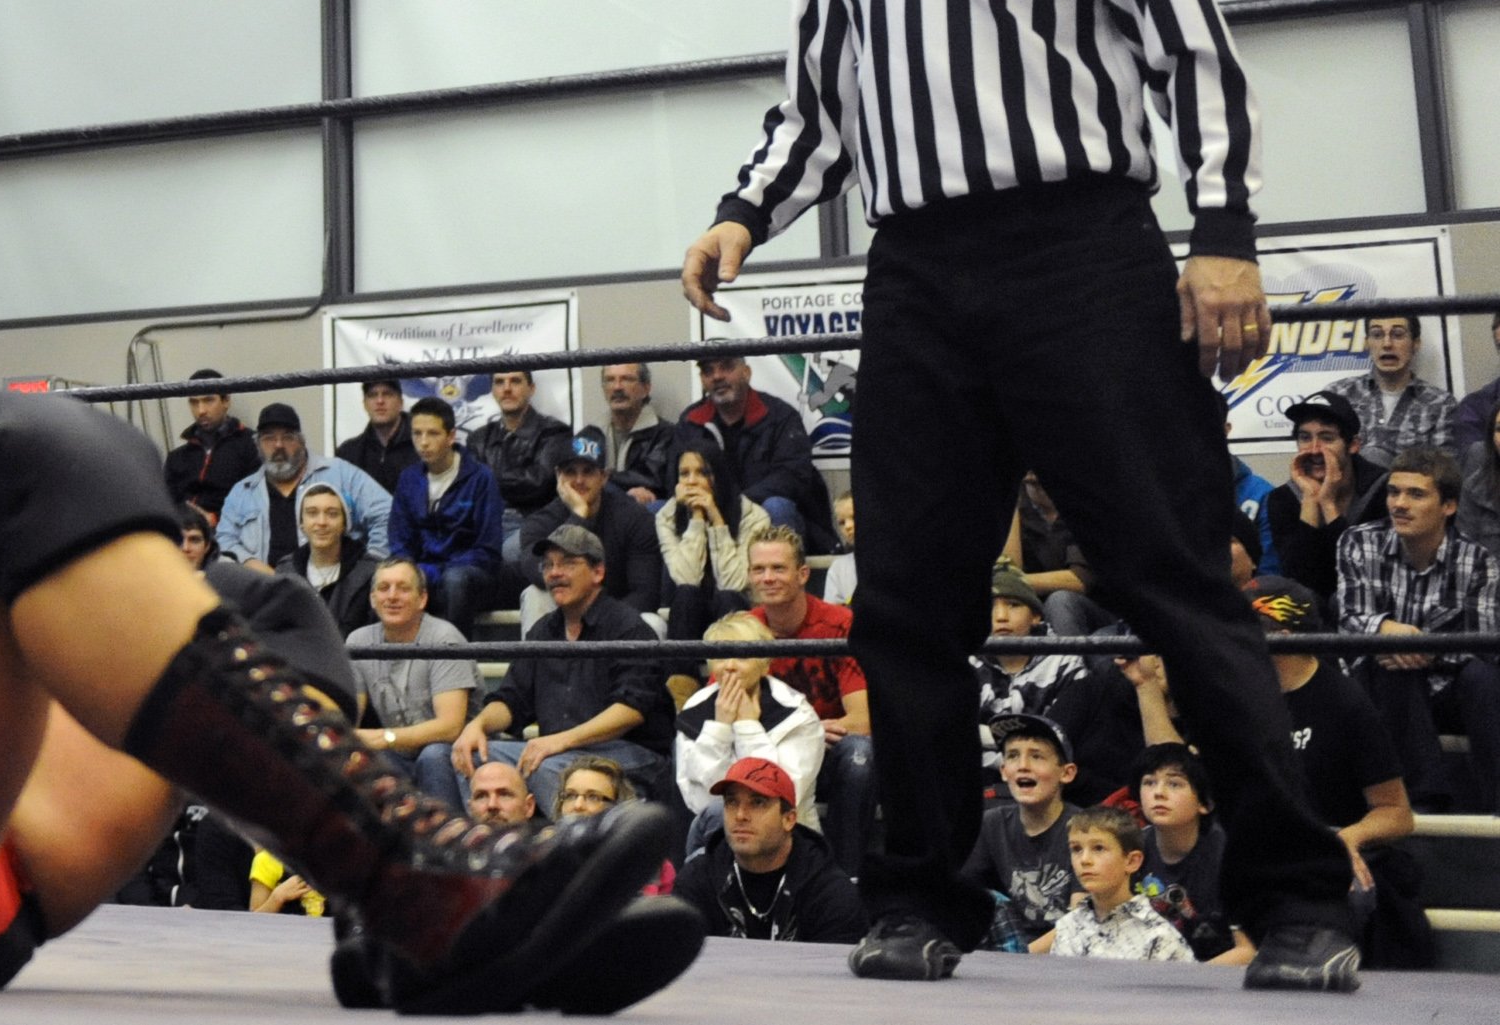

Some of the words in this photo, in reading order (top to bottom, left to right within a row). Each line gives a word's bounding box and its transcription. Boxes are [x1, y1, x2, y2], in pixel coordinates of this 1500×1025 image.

[761, 294, 836, 310] PORTAGE
[375, 325, 437, 342] Tradition
[440, 324, 455, 342] of
[458, 319, 534, 337] Excellence
